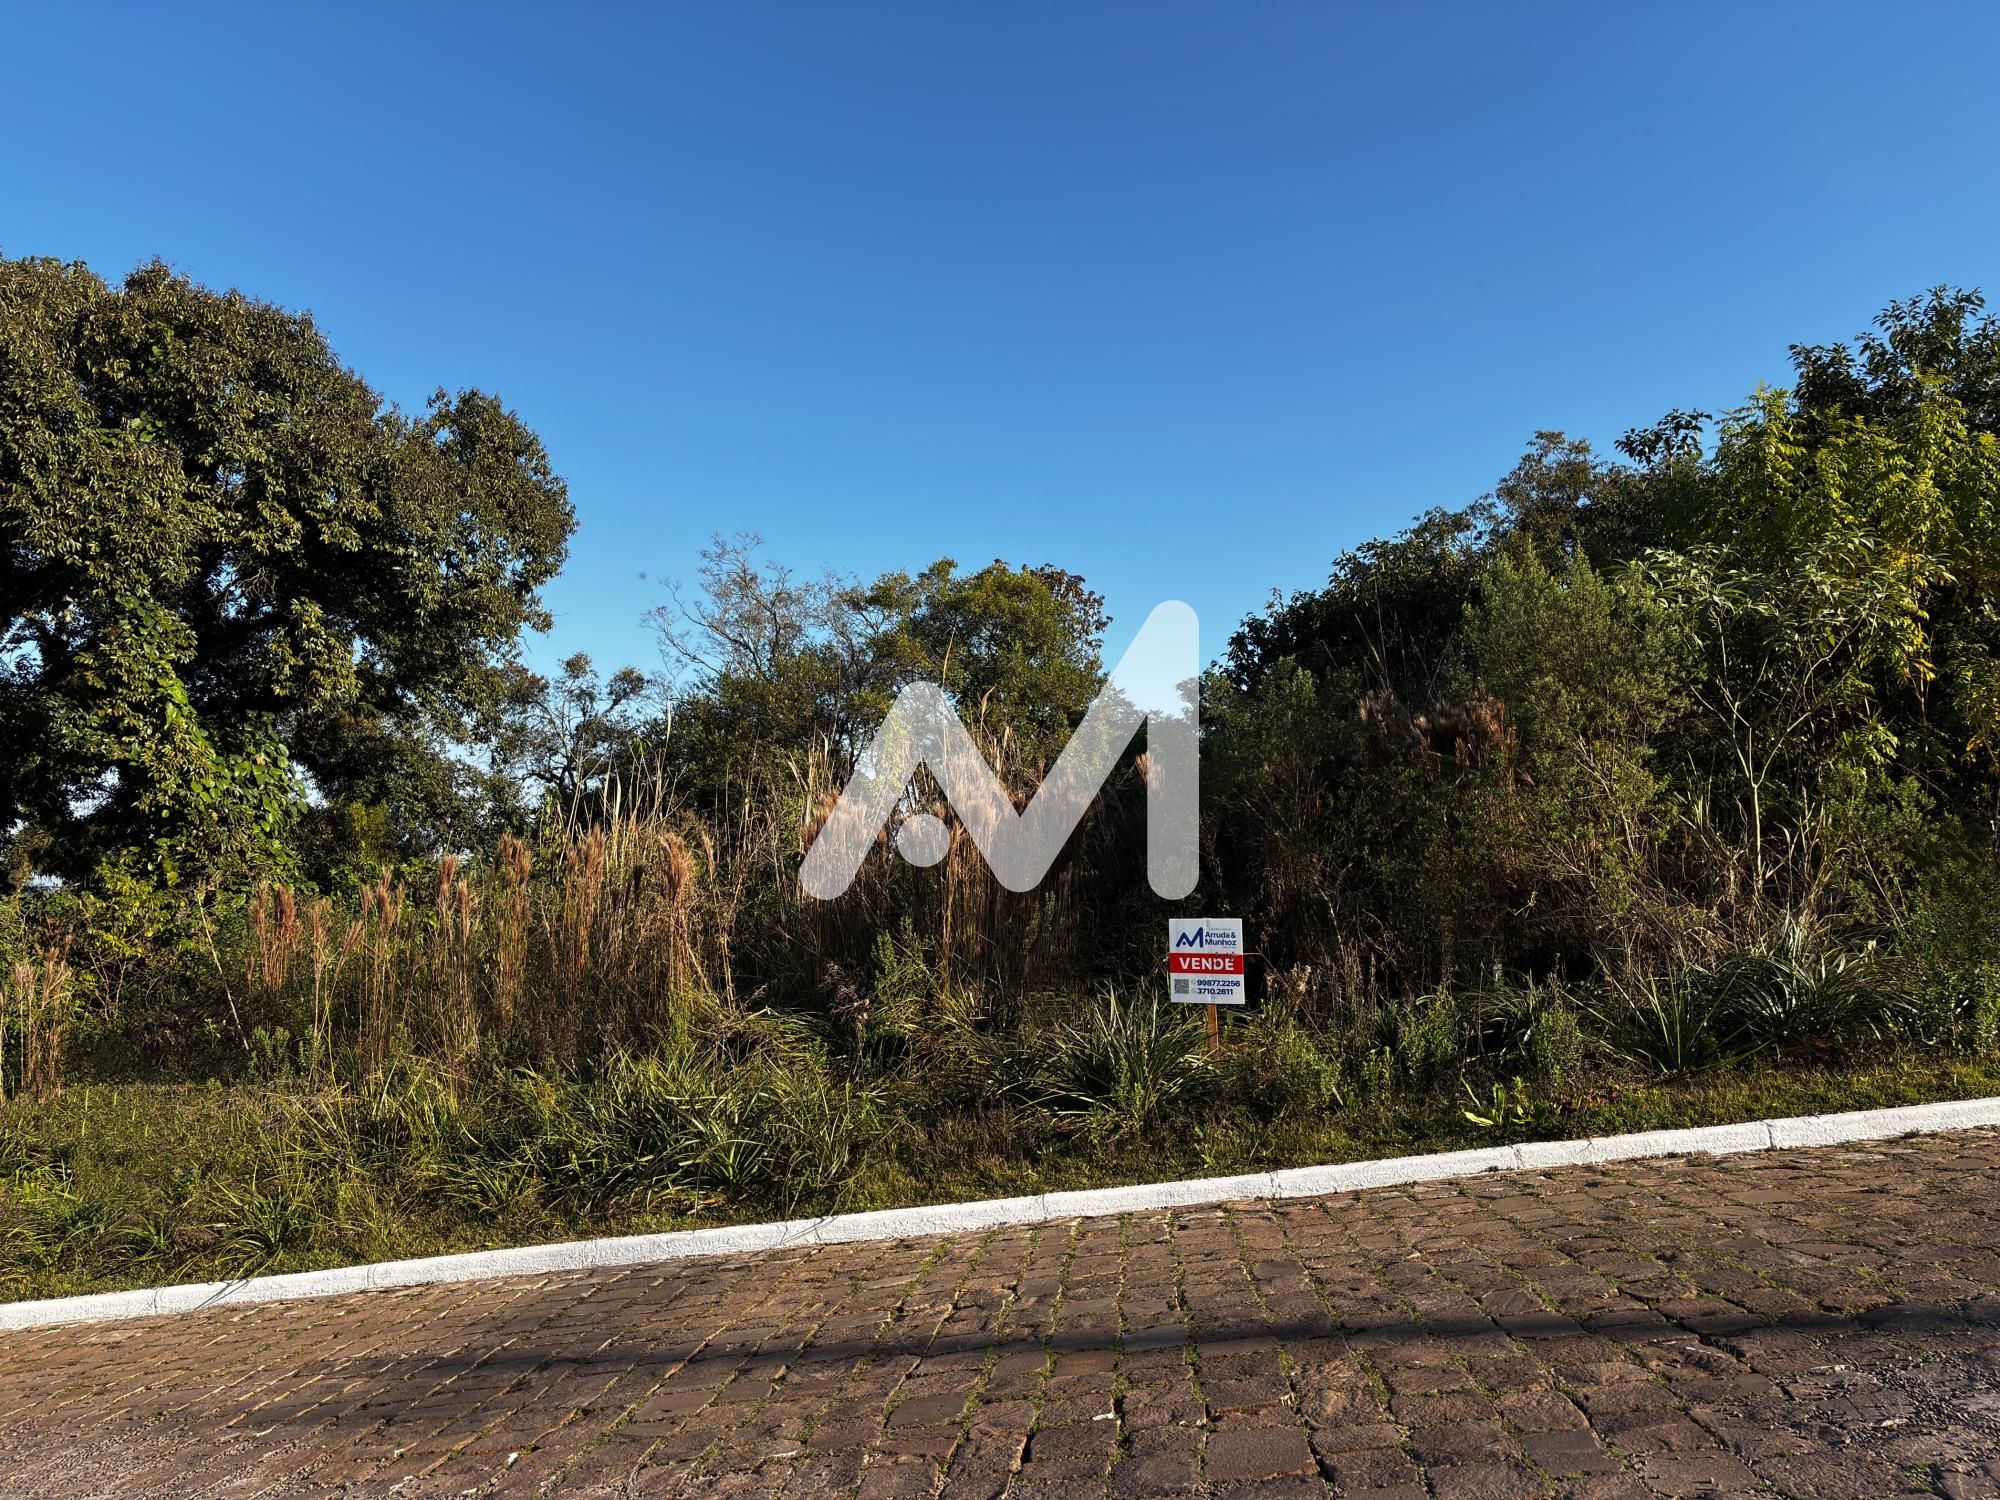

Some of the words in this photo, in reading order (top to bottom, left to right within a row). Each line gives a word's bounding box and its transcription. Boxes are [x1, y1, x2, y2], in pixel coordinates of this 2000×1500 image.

[1205, 931, 1230, 939] Arruda
[1179, 957, 1234, 971] VENDE
[1197, 979, 1240, 987] 99877.2256
